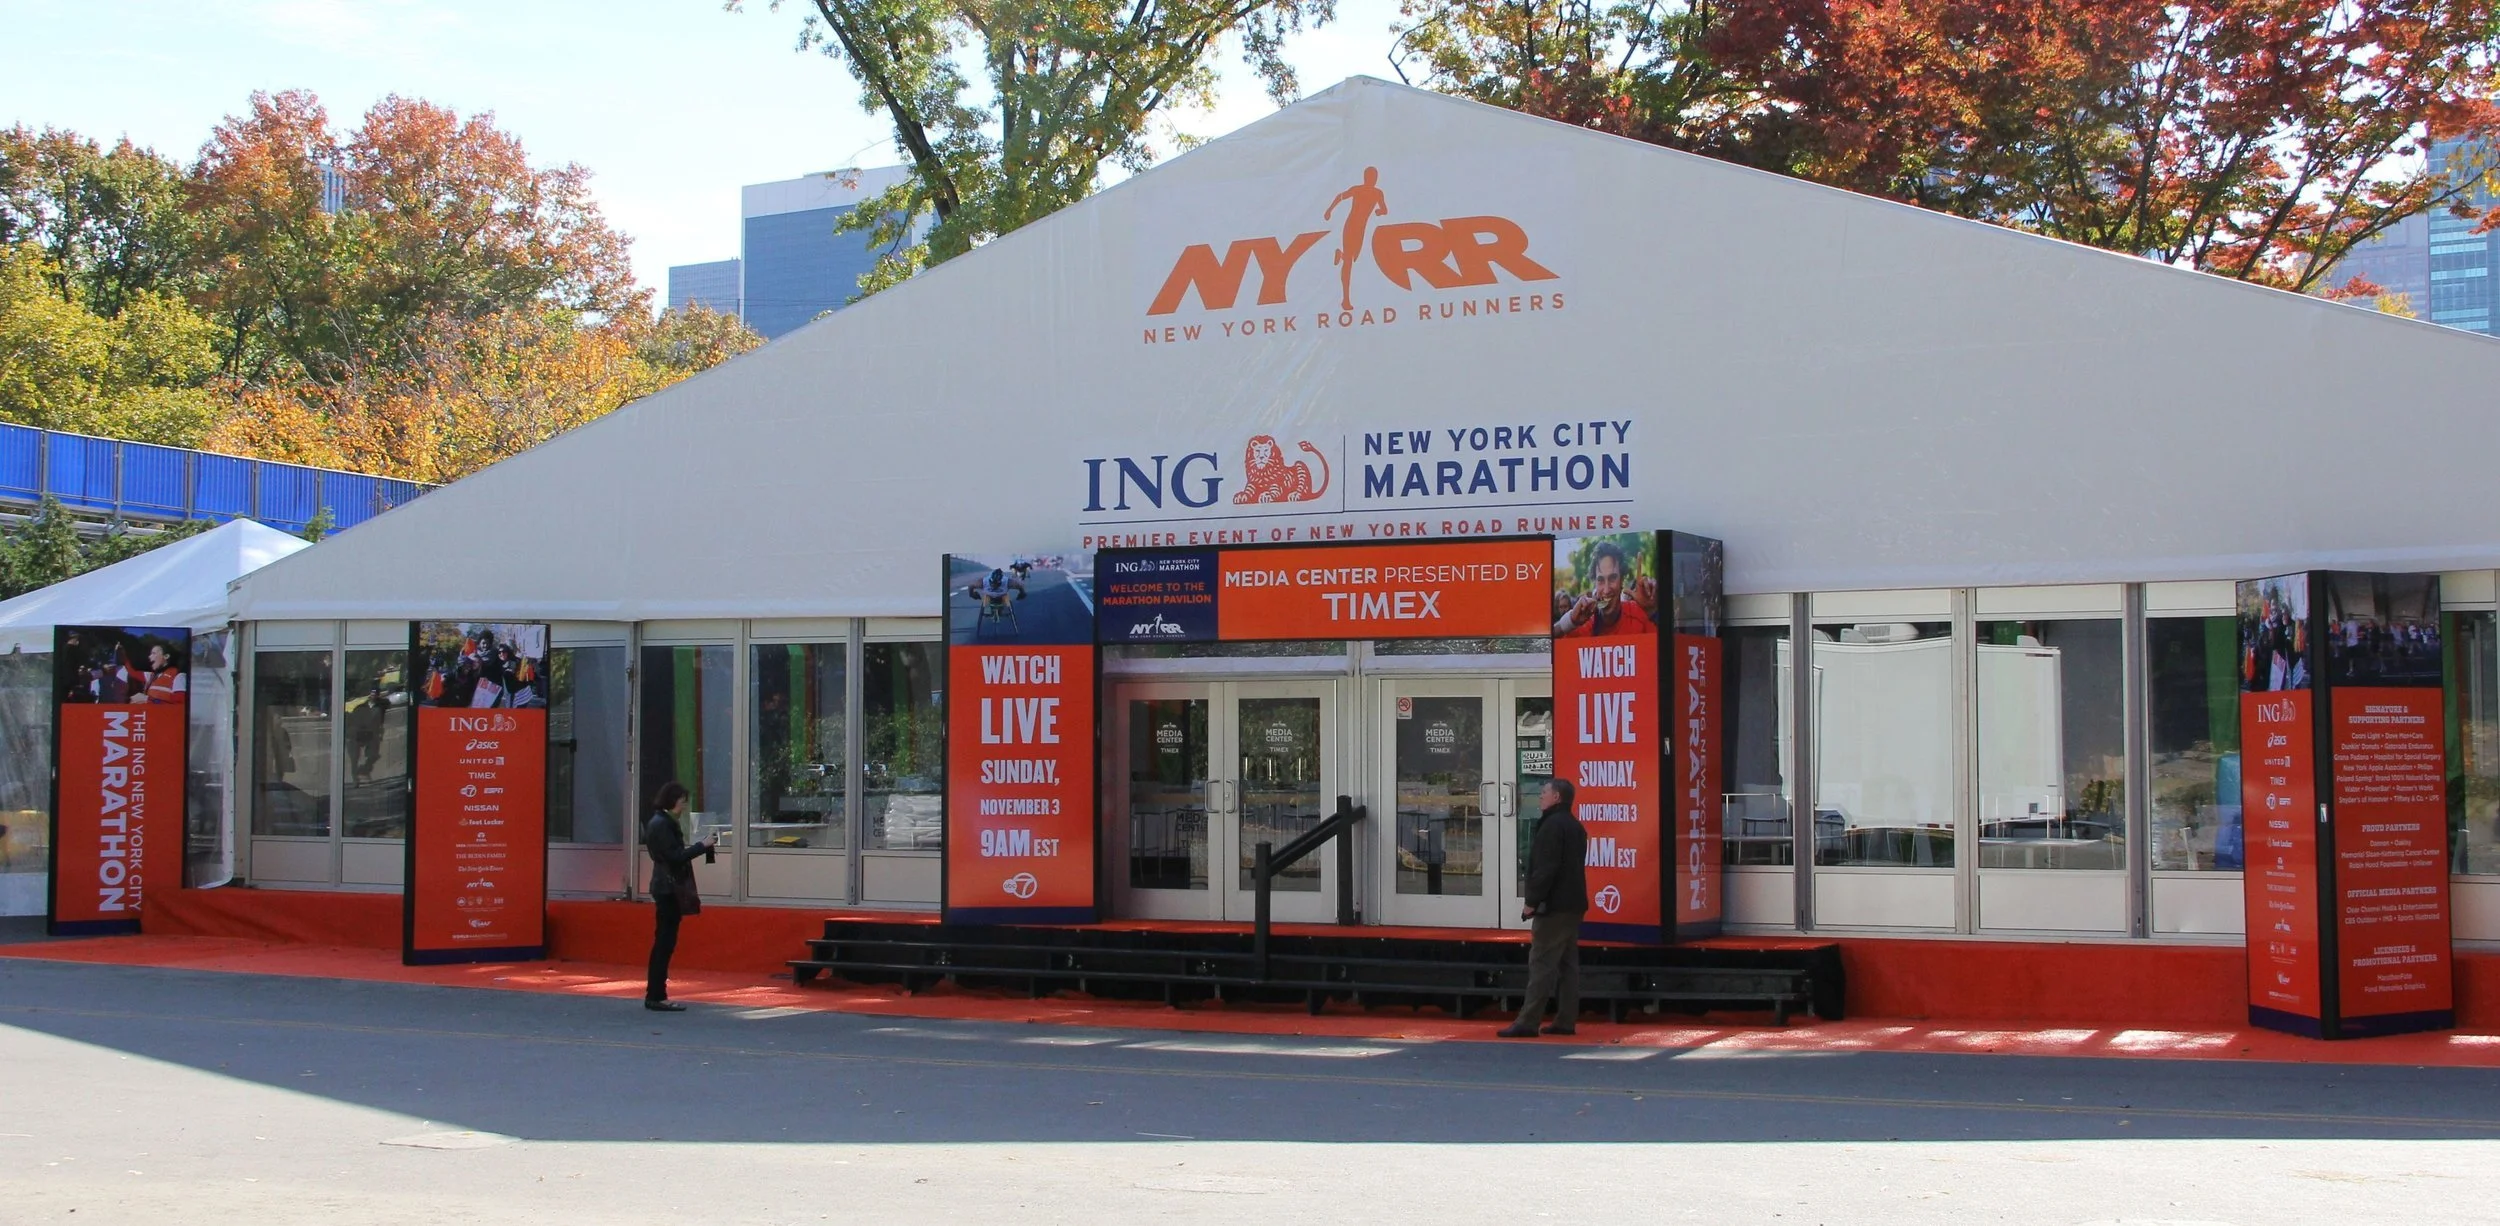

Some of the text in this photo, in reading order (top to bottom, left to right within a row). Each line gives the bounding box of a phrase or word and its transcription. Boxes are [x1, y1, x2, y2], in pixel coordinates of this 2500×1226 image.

[1144, 293, 1565, 344] NEW YORK ROAD RUNNERS
[1364, 420, 1632, 455] NEW YORK CITY
[1083, 451, 1224, 512] ING
[1364, 453, 1631, 499] MARATHON
[1083, 515, 1631, 549] PREMIER EVENT OF NEW YORK ROAD RUNNERS
[1115, 562, 1138, 572] ING
[1159, 563, 1200, 571] MARATHON
[1225, 563, 1543, 587] MEDIA CENTER PRESENTED BY
[1110, 582, 1205, 593] WELCOME TO THE
[1103, 594, 1211, 606] MARATHON PAVILION
[1322, 590, 1441, 620] TIMEX
[981, 655, 1060, 684] WATCH
[1578, 645, 1636, 678] WATCH
[449, 717, 488, 732] ING
[981, 697, 1060, 744] LIVE
[1578, 692, 1636, 744] LIVE
[2257, 704, 2280, 723] ING
[2348, 716, 2390, 724] SUPPORTING
[477, 741, 500, 749] asics
[2367, 732, 2380, 740] Light
[981, 759, 1060, 786] SUNDAY,
[1579, 761, 1637, 790] SUNDAY,
[1688, 645, 1700, 910] MARATHON
[2270, 776, 2286, 785] TIMEX
[99, 711, 129, 912] MARATHON
[129, 711, 146, 911] THE ING NEW YORK CITY
[980, 799, 1060, 815] NOVEMBER 3
[1579, 804, 1637, 822] NOVEMBER 3
[2269, 820, 2290, 829] NISSAN
[2362, 823, 2420, 832] PROUD PARTNERS
[981, 829, 1059, 857] 9AM EST
[1618, 848, 1637, 868] EST
[2347, 886, 2436, 898] OFFICIAL MEDIA PARTNERS
[2353, 954, 2437, 967] PROMOTIONAL PARTNERS
